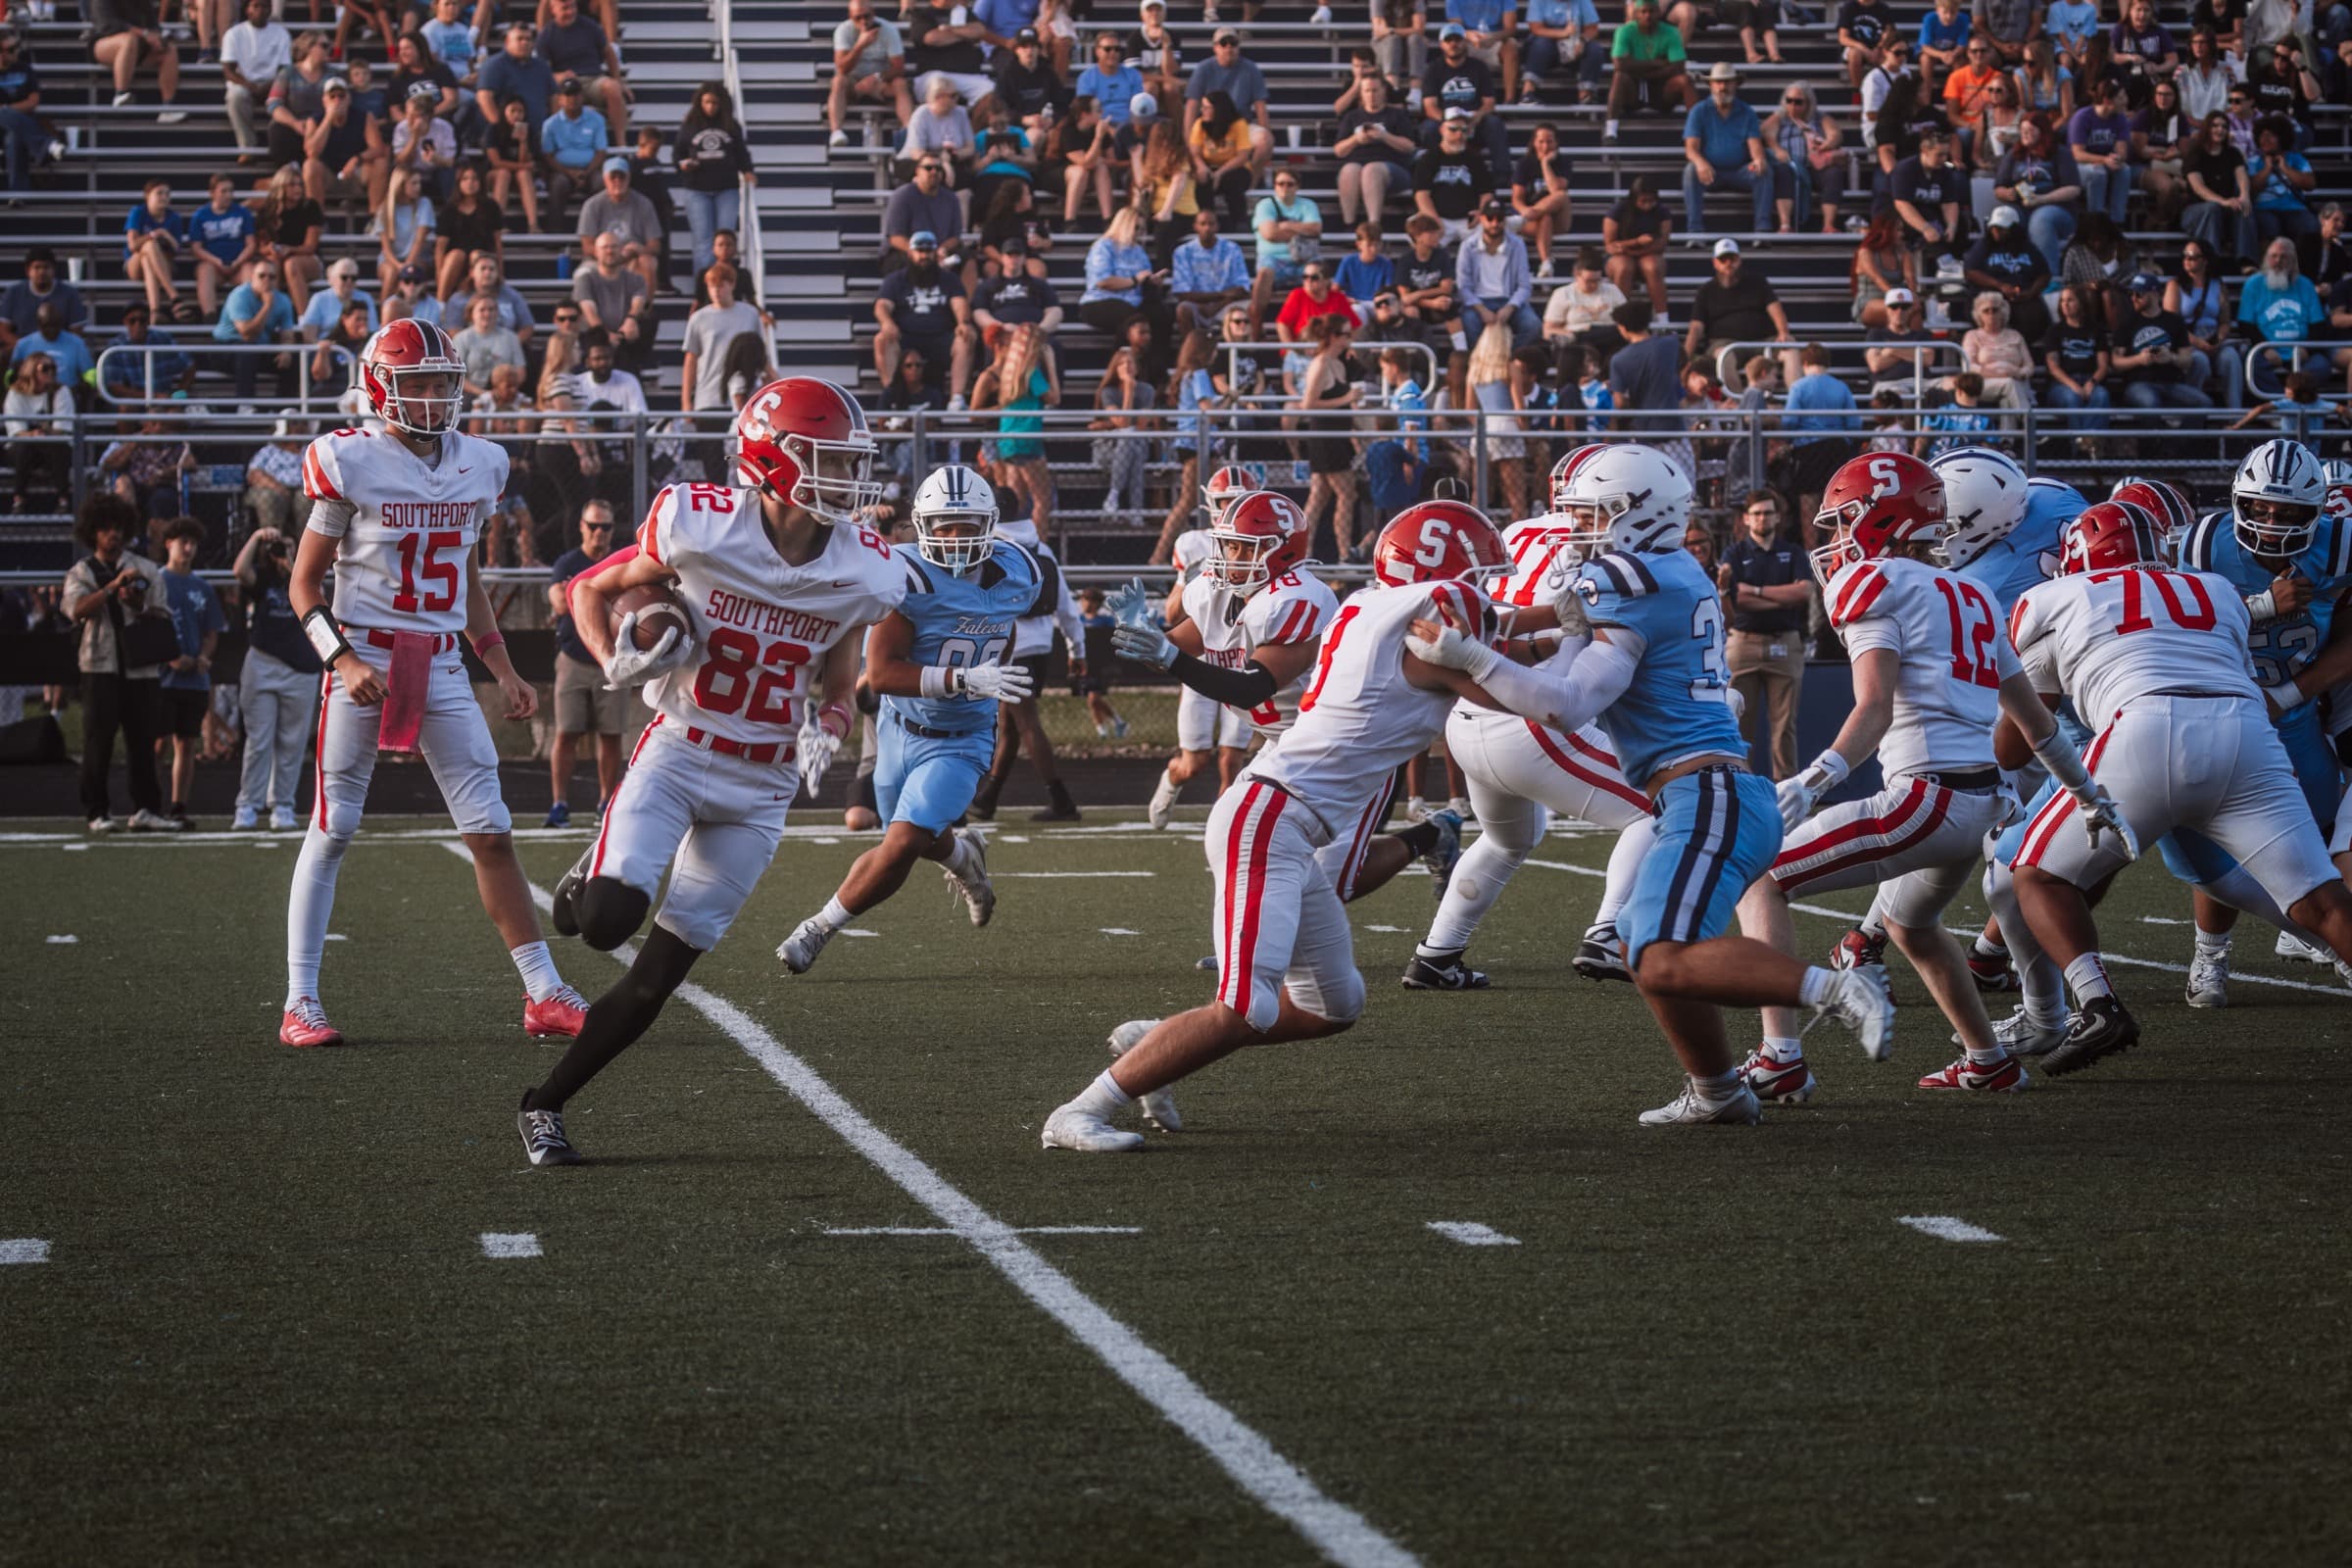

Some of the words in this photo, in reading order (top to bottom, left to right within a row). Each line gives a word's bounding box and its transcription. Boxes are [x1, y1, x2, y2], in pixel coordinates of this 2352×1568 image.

[744, 391, 782, 441] S
[1869, 458, 1901, 496] S
[381, 502, 477, 528] SOUTHPORT
[1269, 498, 1296, 538] S
[2065, 517, 2087, 560] S
[2118, 517, 2129, 527] 70
[1414, 517, 1451, 568] S
[1494, 527, 1572, 607] 77
[392, 531, 462, 613] 15
[705, 589, 840, 645] SOUTHPORT
[2087, 569, 2217, 636] 70
[1935, 577, 2001, 690] 12
[694, 626, 811, 725] 82
